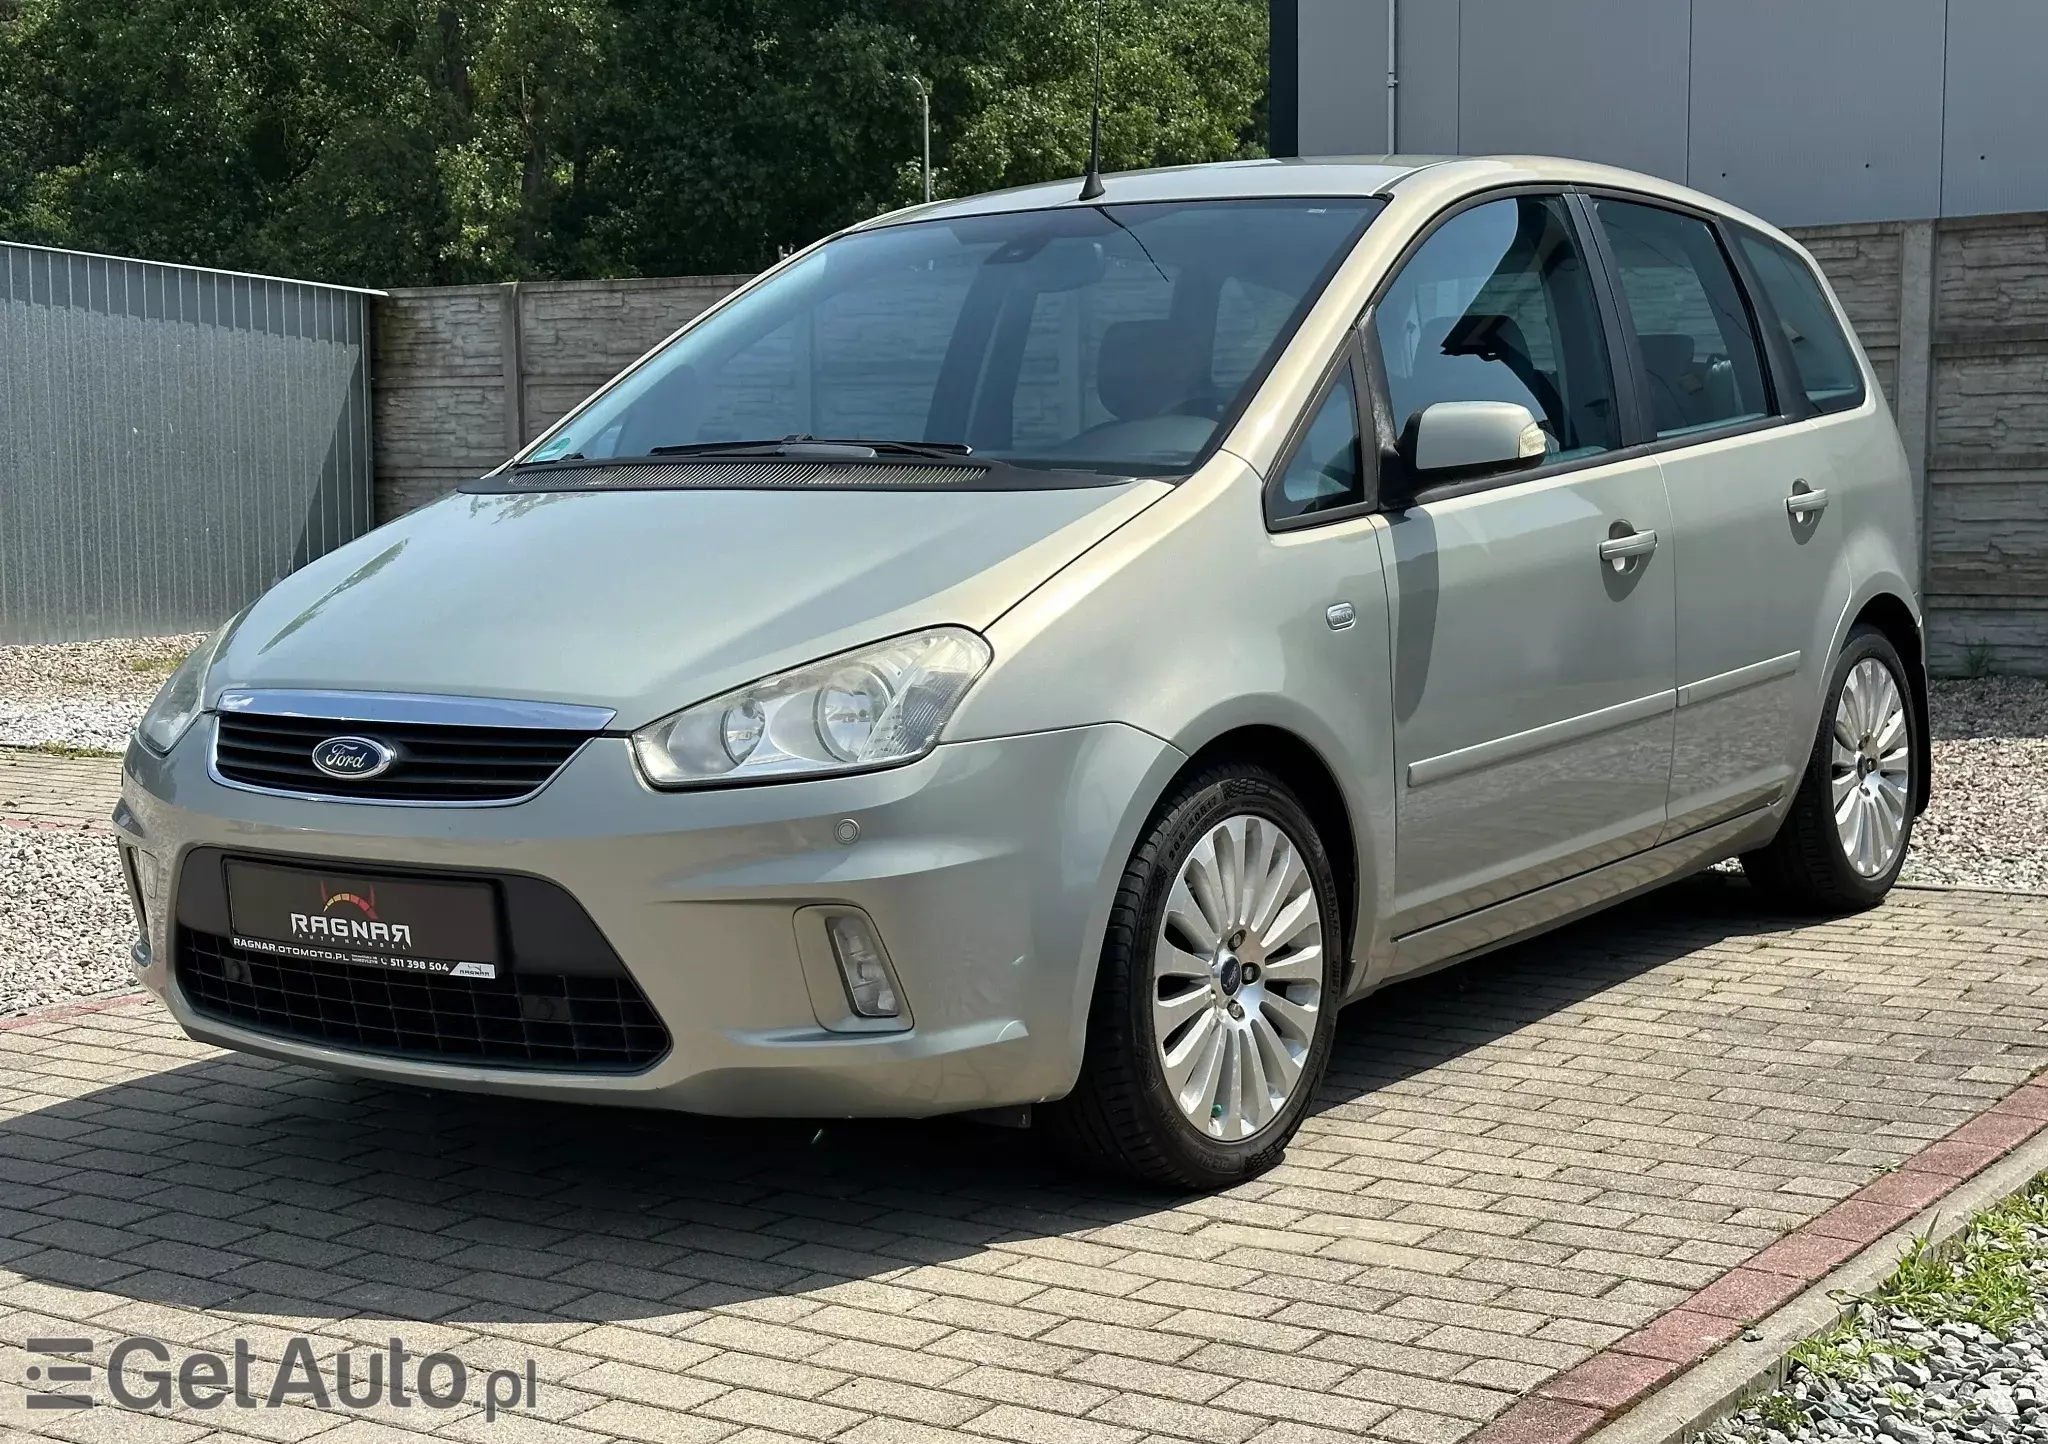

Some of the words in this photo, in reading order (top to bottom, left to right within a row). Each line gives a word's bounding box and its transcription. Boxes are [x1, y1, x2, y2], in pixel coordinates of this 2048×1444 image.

[325, 743, 368, 768] Ford
[290, 913, 412, 947] RAGNAR
[233, 937, 350, 961] RAGNAR.OTOMOTO.PL
[390, 958, 405, 968] 511
[406, 960, 427, 970] 398
[428, 962, 450, 972] 504
